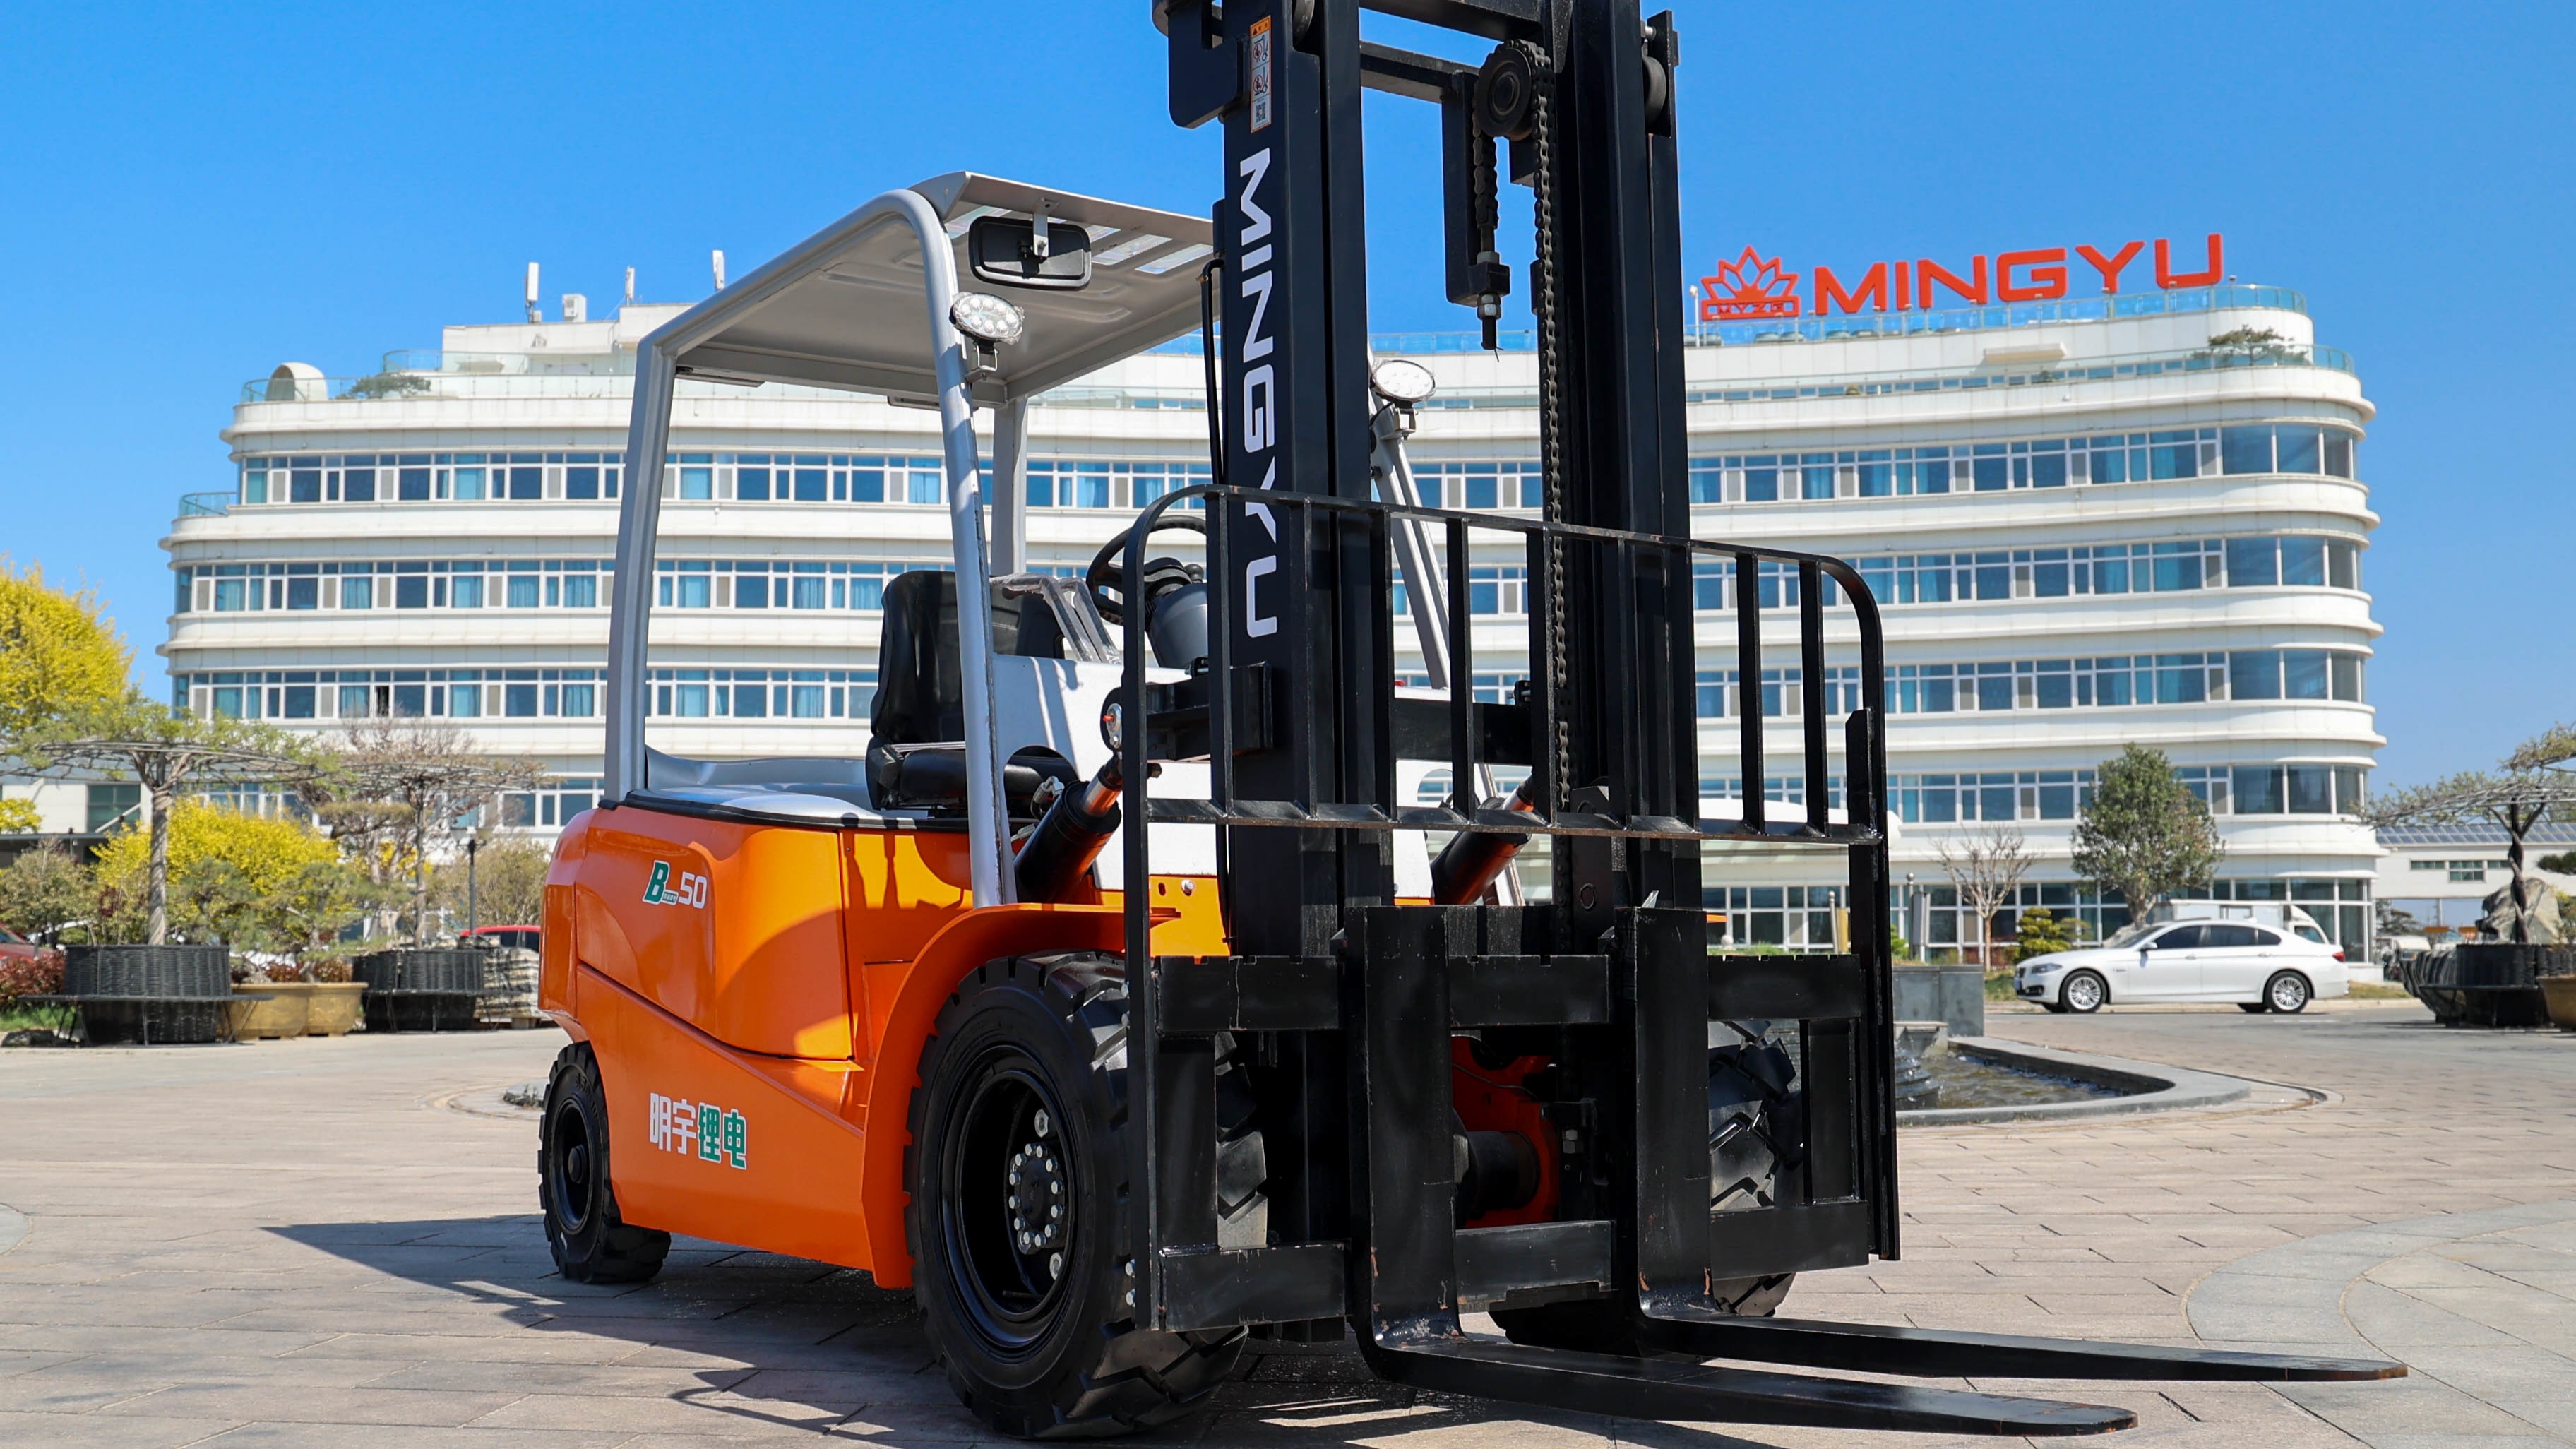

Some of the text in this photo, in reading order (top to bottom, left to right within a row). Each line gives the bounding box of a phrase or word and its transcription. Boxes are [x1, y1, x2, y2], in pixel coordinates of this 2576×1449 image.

[1815, 234, 2222, 316] MINGYU
[1239, 147, 1277, 638] MINGYU
[649, 1092, 747, 1171] 明宇锂电
